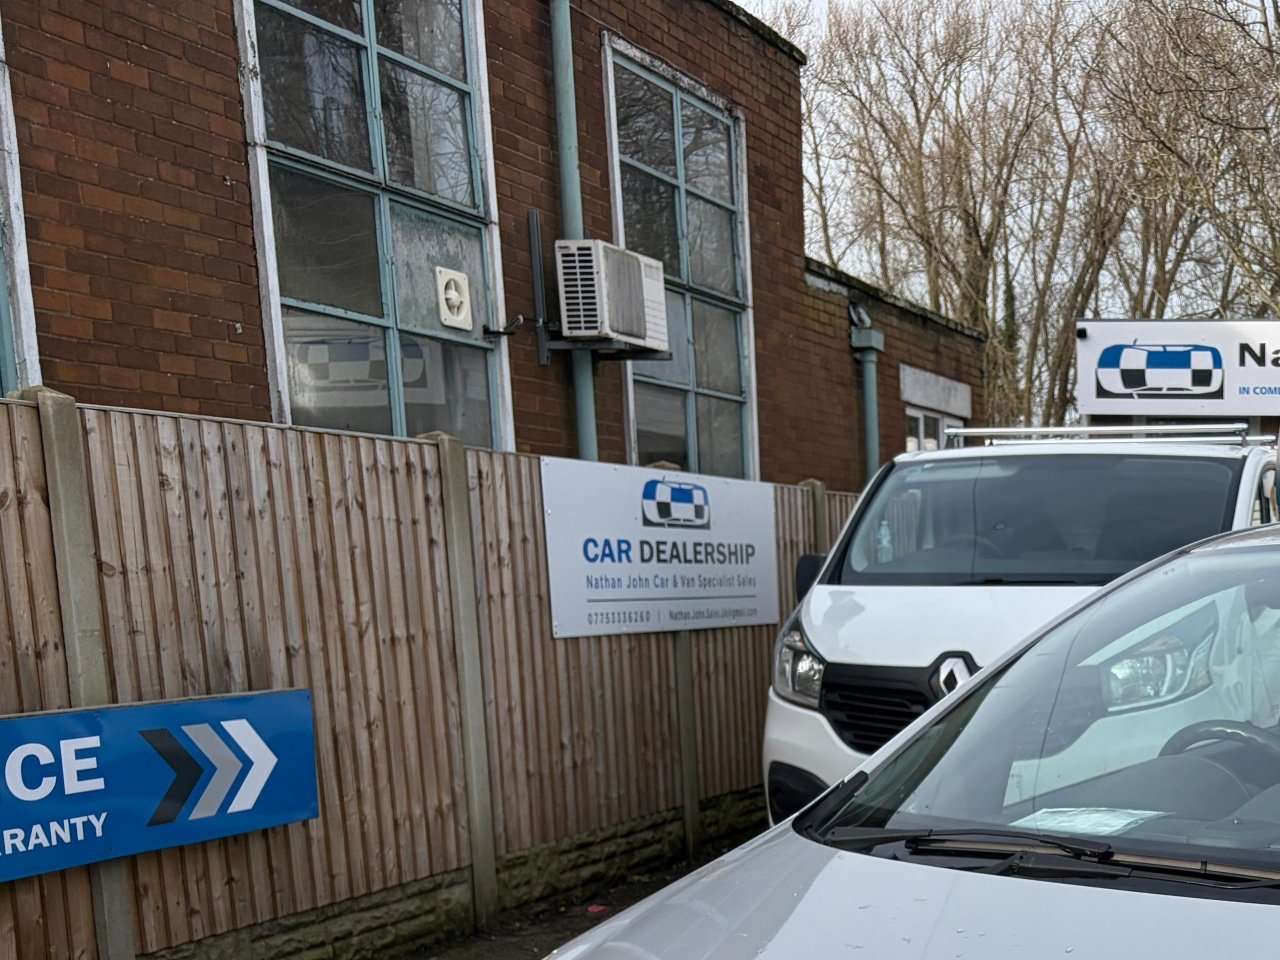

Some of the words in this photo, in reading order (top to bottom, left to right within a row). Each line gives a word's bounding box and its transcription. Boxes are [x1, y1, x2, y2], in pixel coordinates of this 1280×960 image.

[1238, 386, 1250, 395] IN
[583, 538, 633, 563] CAR
[639, 540, 756, 565] DEALERSHIP
[586, 575, 623, 589] Nathan
[626, 575, 650, 589] John
[653, 575, 669, 589] Car
[672, 575, 679, 588] &
[680, 576, 696, 588] Van
[697, 575, 735, 590] Specialist
[737, 575, 757, 588] Sales
[5, 736, 105, 801] CE
[0, 812, 108, 856] RANTY
